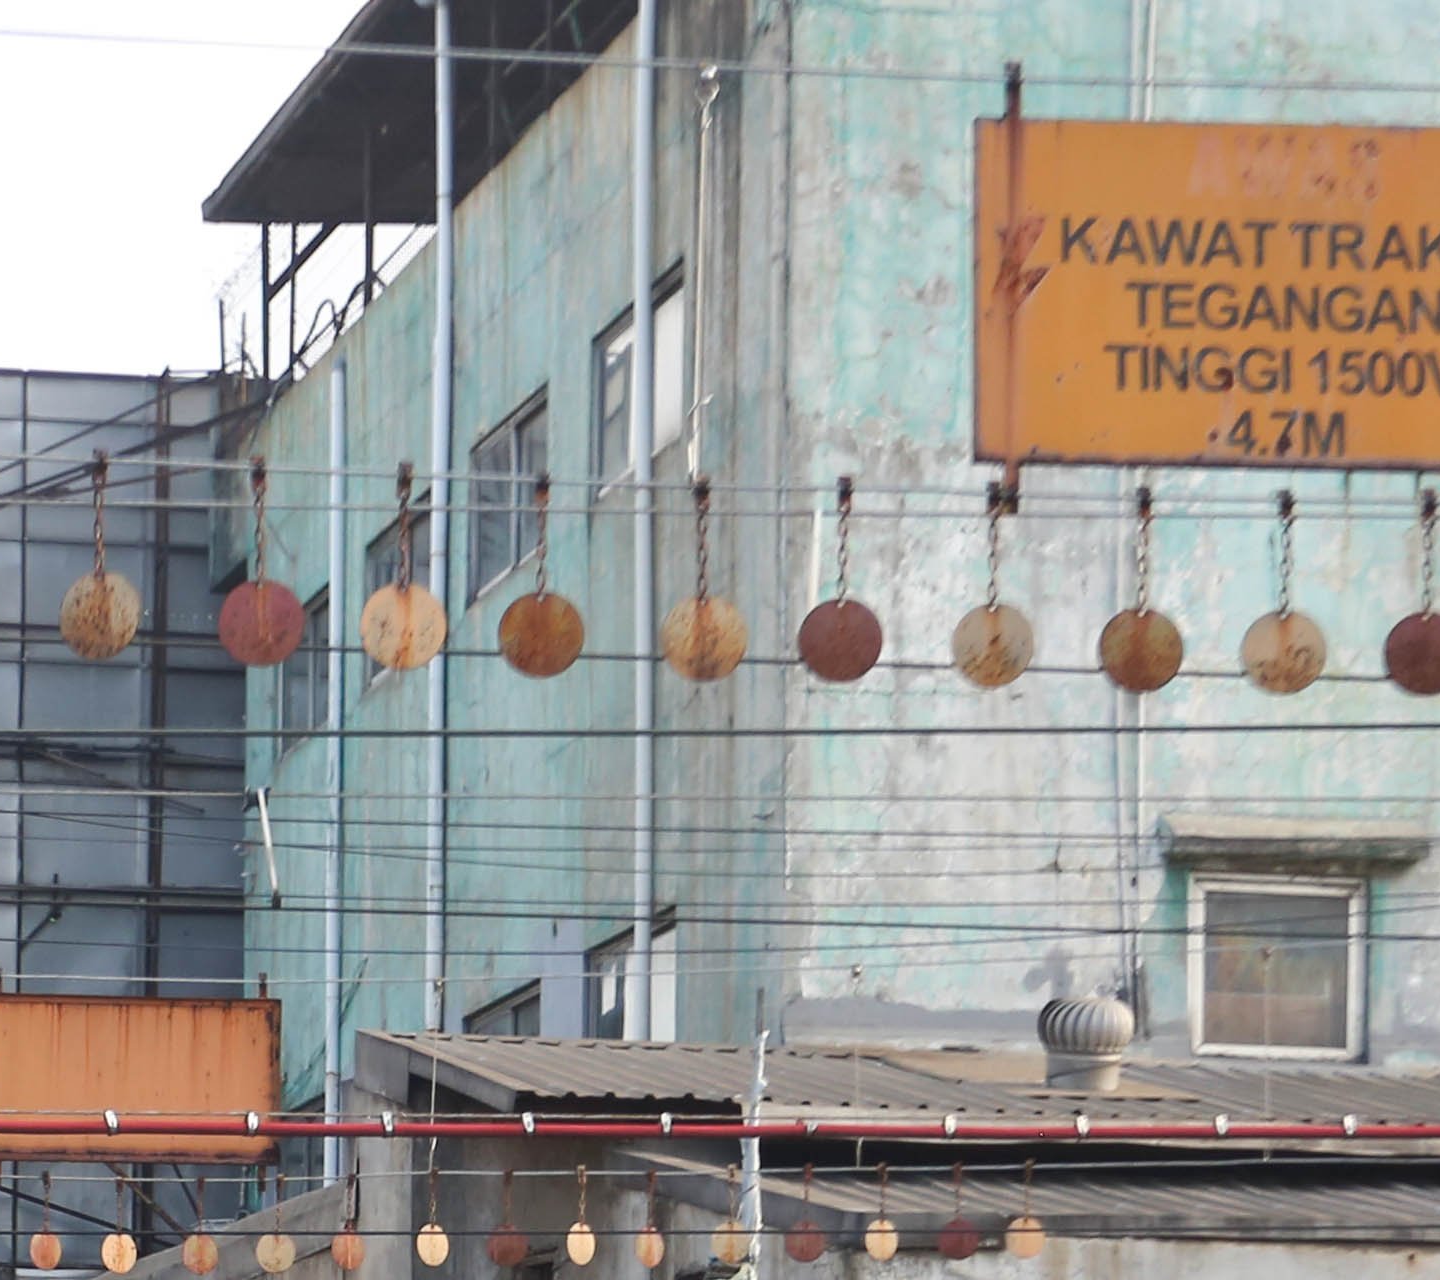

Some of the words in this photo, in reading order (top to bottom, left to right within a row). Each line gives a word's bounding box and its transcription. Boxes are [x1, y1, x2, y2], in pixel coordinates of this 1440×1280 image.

[1059, 217, 1277, 267] KAWAT
[1104, 344, 1291, 394] TINGGI
[1227, 411, 1346, 457] 4.7M
